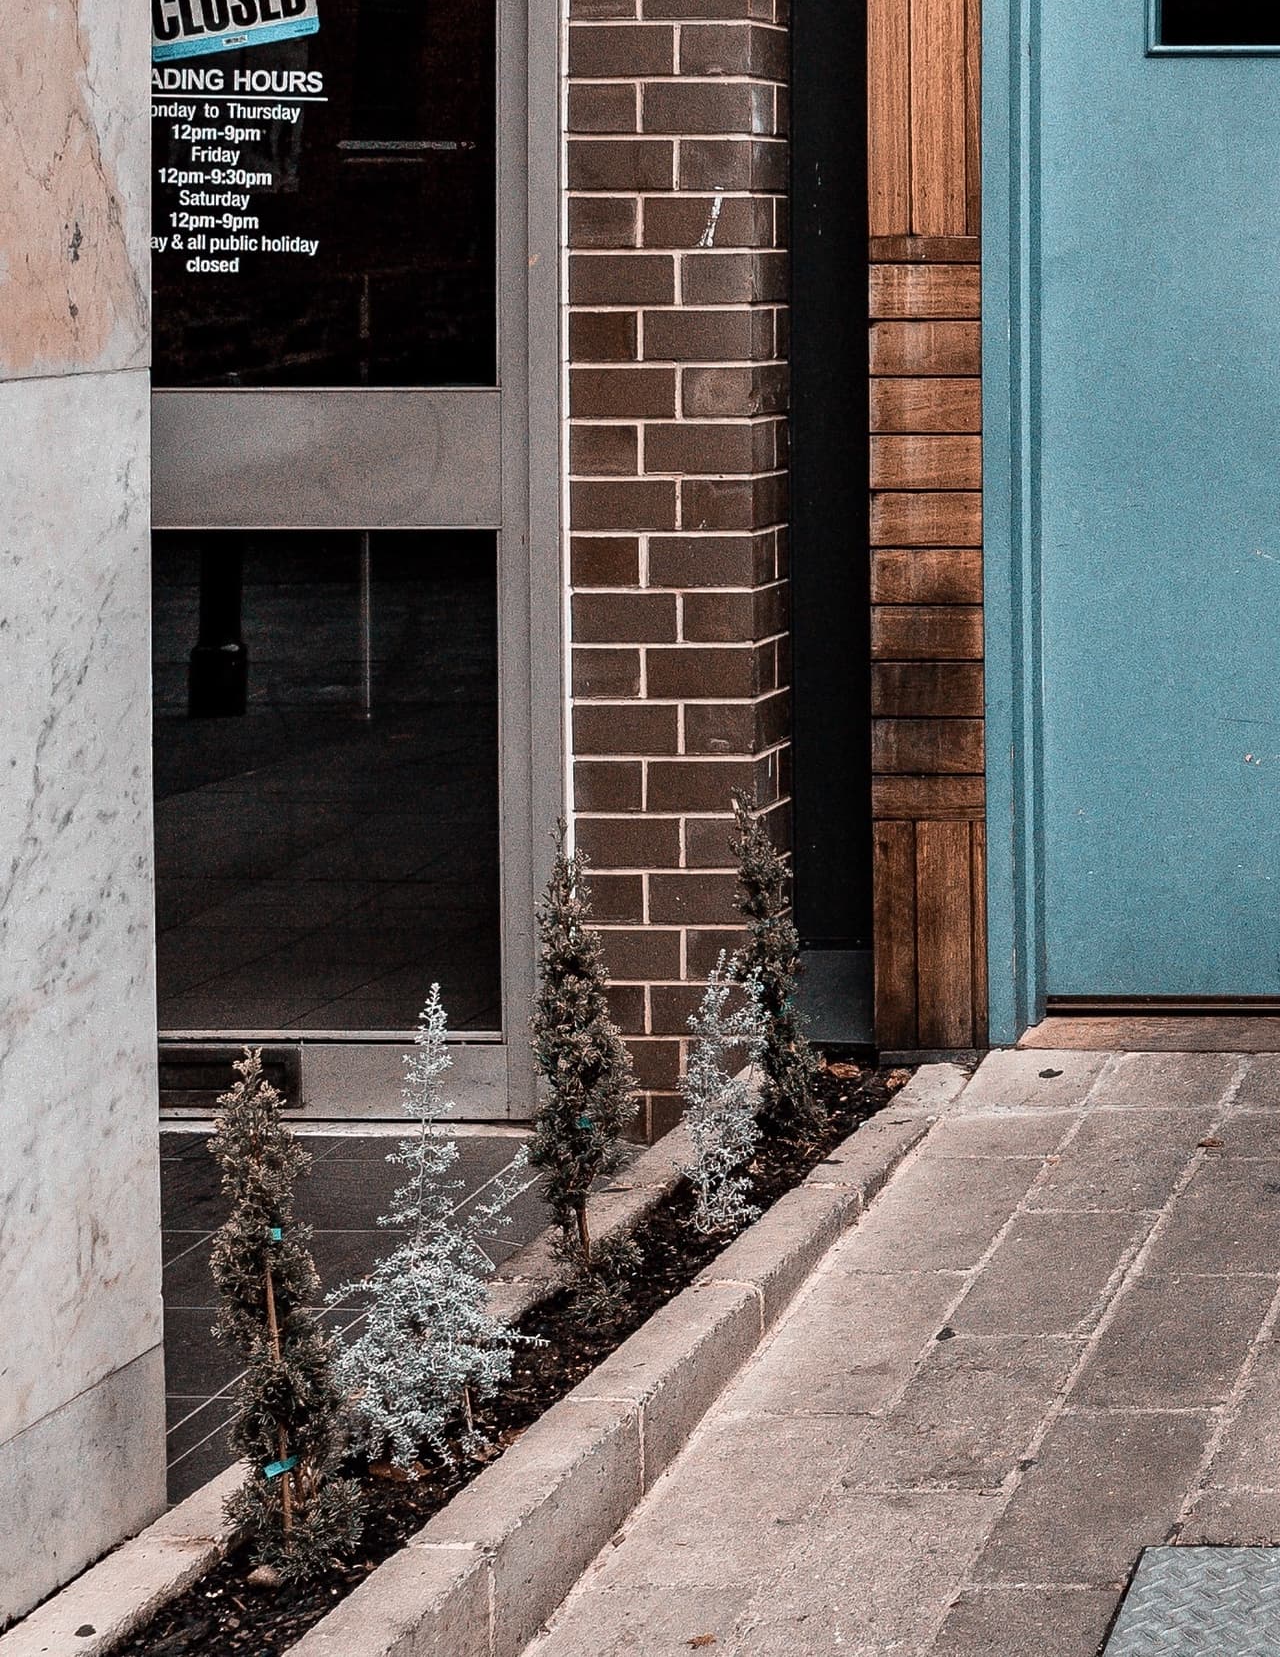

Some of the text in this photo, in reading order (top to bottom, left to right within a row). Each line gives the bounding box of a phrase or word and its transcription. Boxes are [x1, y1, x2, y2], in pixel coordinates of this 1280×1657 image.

[233, 69, 323, 93] HOURS
[204, 103, 220, 118] to
[227, 103, 301, 124] Thursday
[171, 124, 261, 144] 12pm-9pm
[191, 146, 240, 166] Friday
[158, 167, 273, 187] 12pm-9:30pm
[179, 189, 250, 210] Saturday
[169, 212, 259, 231] 12pm-9pm
[171, 235, 184, 250] &
[187, 234, 206, 250] all
[209, 235, 258, 253] public
[261, 236, 319, 256] holiday
[186, 256, 240, 273] closed
